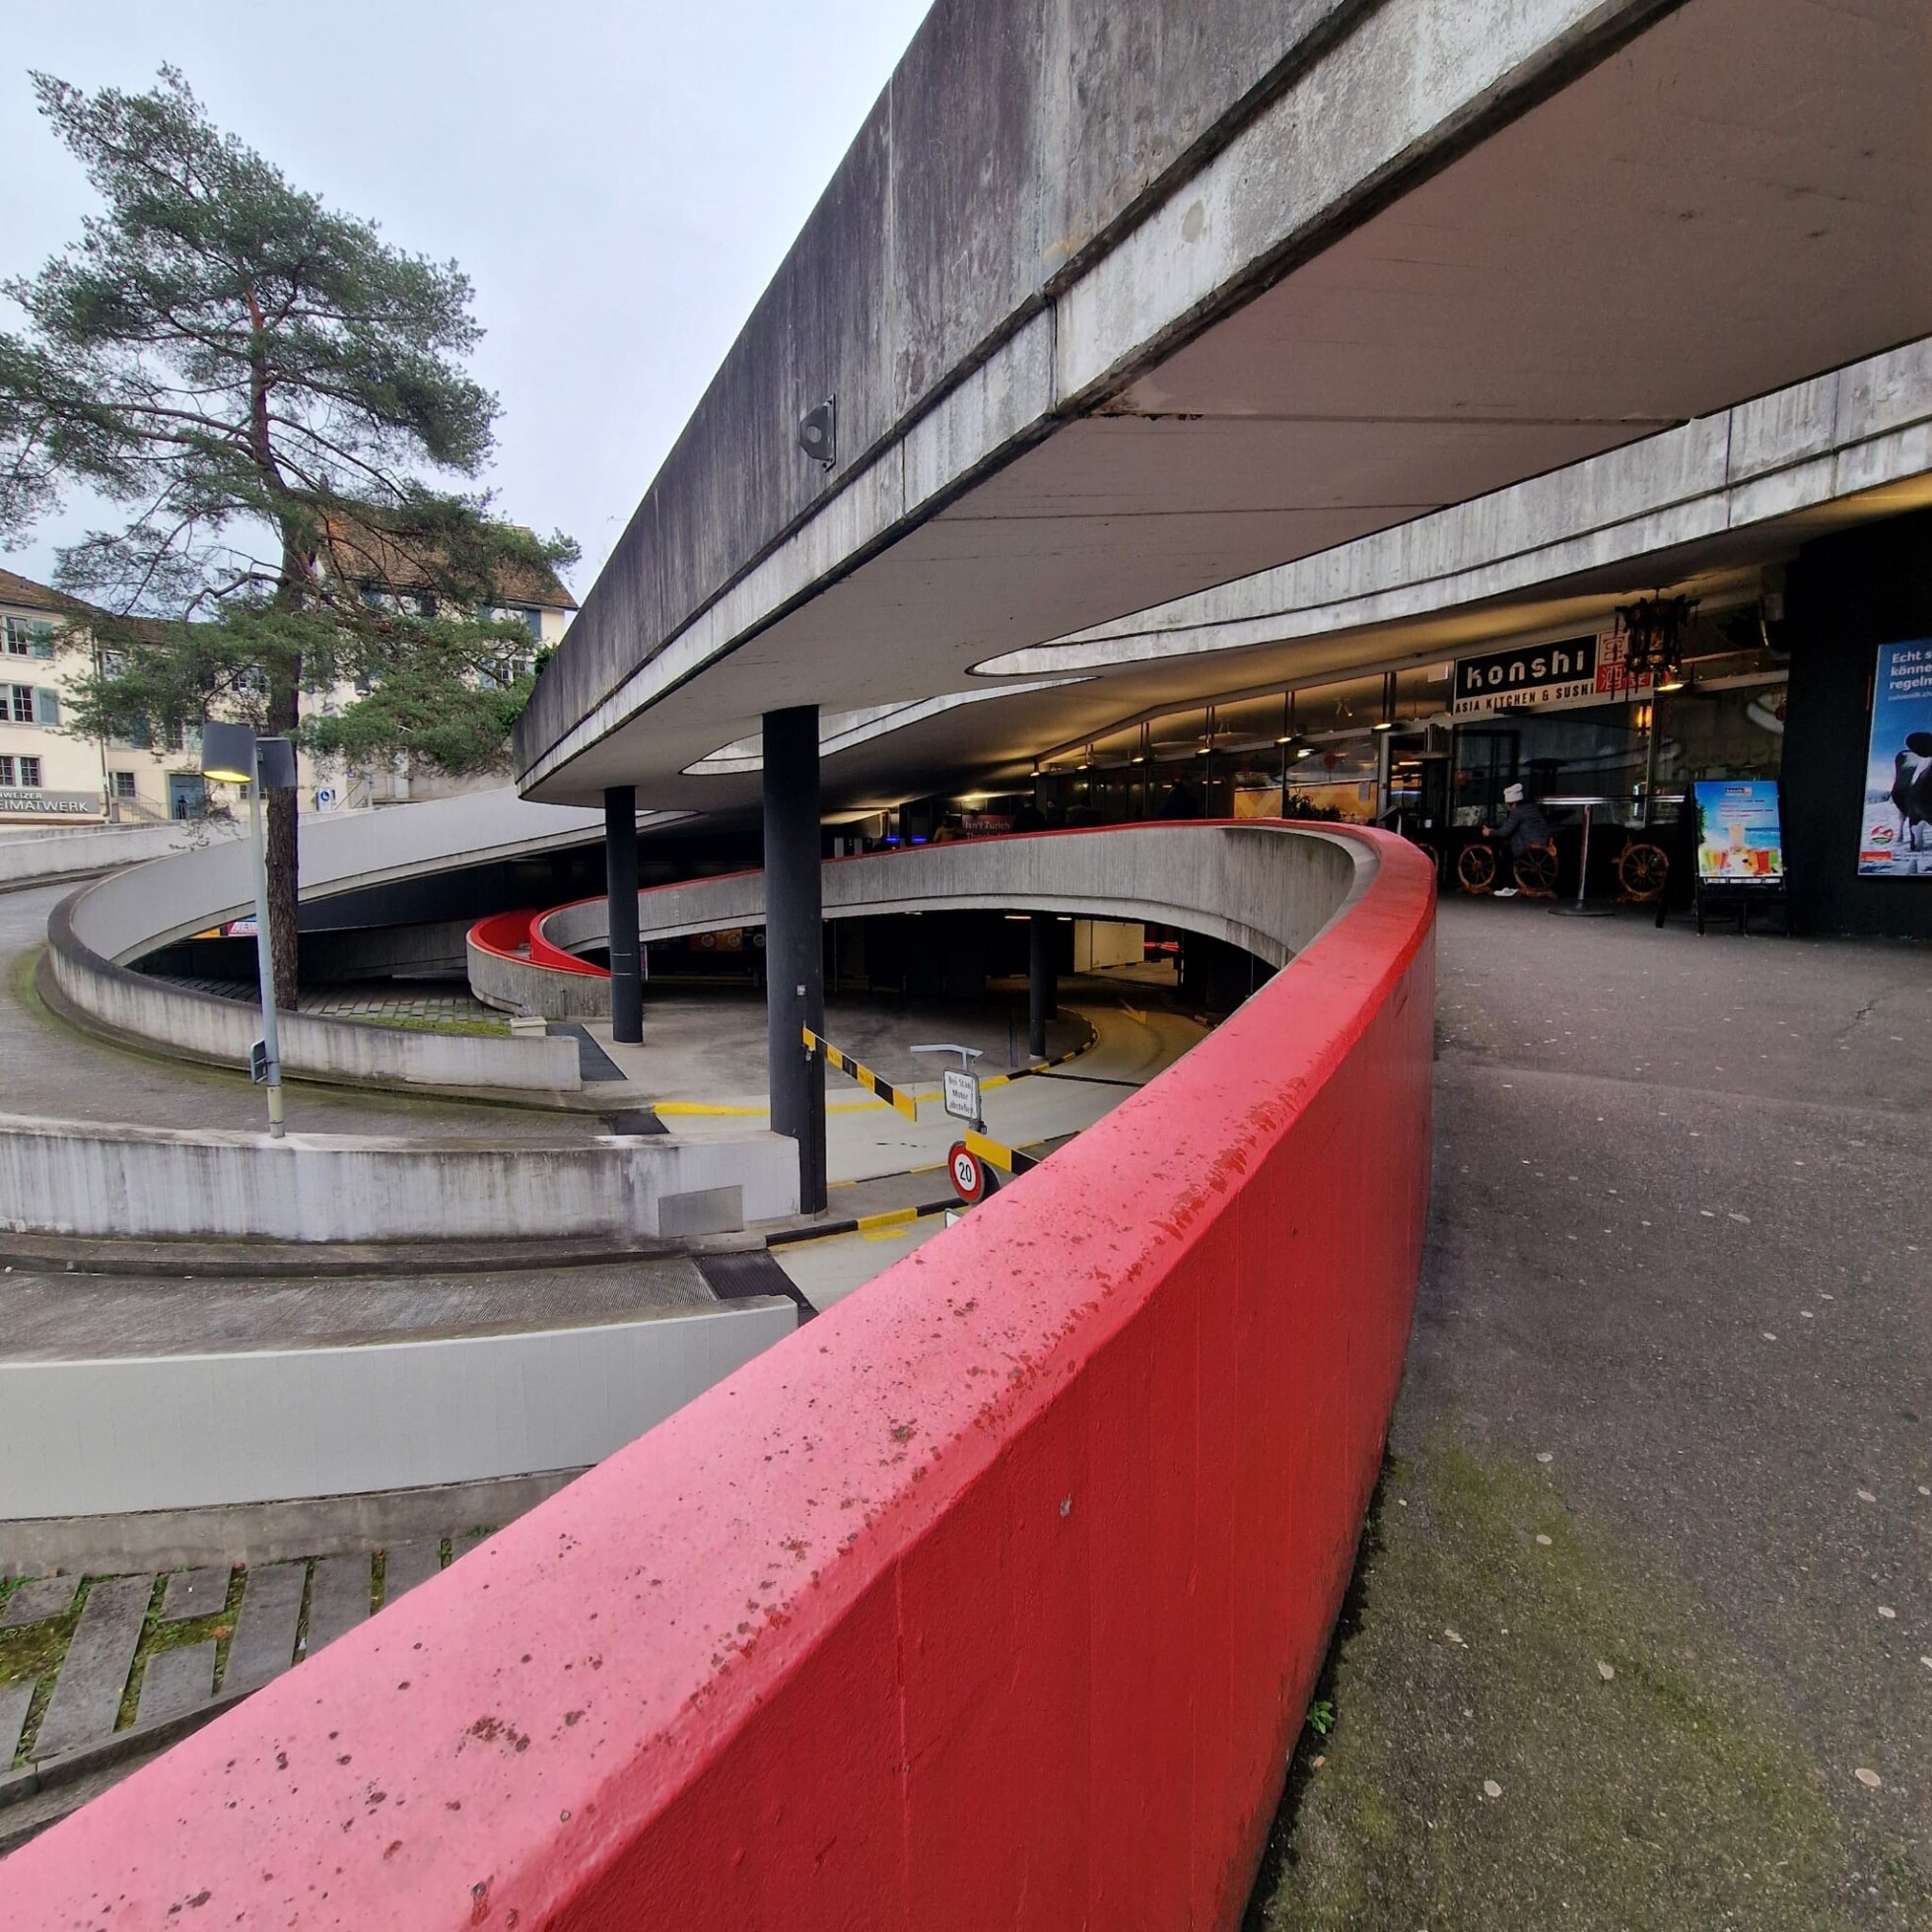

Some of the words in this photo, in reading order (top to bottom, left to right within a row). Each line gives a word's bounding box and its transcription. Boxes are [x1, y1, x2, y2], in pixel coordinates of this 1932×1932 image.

[1466, 650, 1584, 689] konshi
[1893, 651, 1922, 663] Echt
[1456, 700, 1480, 714] ASIA
[1485, 691, 1536, 709] KITCHEN
[1542, 689, 1550, 701] &
[1555, 682, 1594, 699] SUSHI
[958, 1162, 972, 1183] 20
